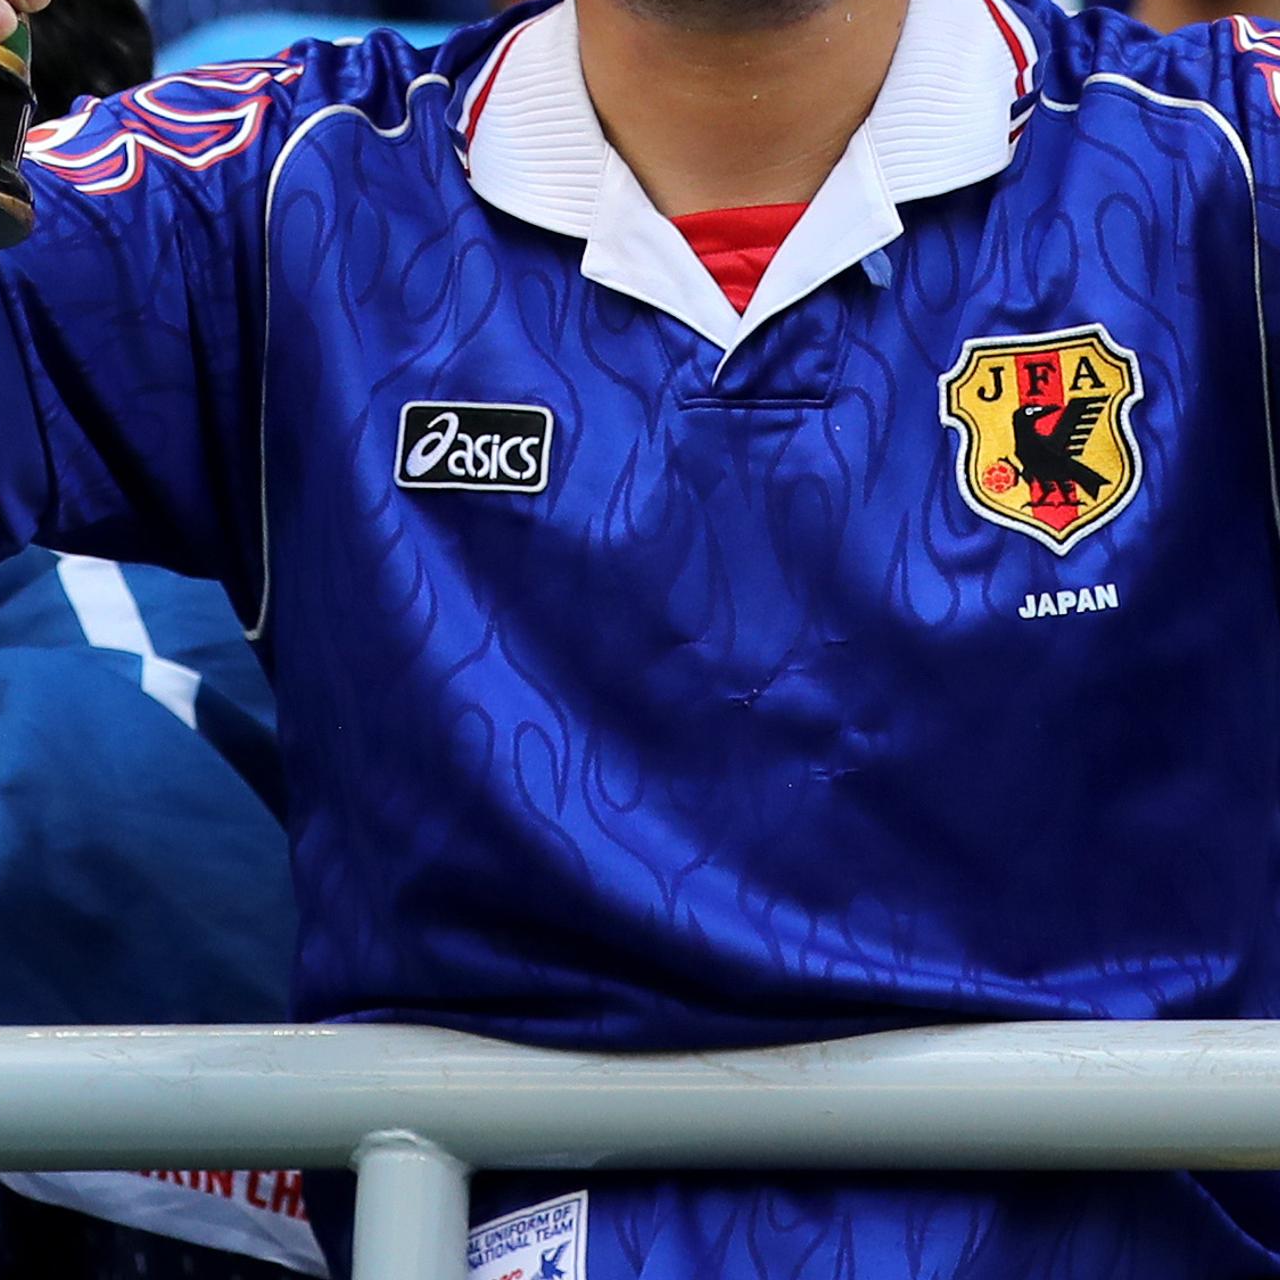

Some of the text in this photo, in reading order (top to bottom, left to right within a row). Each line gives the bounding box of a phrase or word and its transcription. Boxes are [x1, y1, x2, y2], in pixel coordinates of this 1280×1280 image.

[977, 355, 1106, 403] JFA
[1018, 583, 1119, 619] JAPAN
[484, 1213, 550, 1247] UNIFORM
[553, 1205, 573, 1222] OF
[536, 1218, 574, 1243] TEAM
